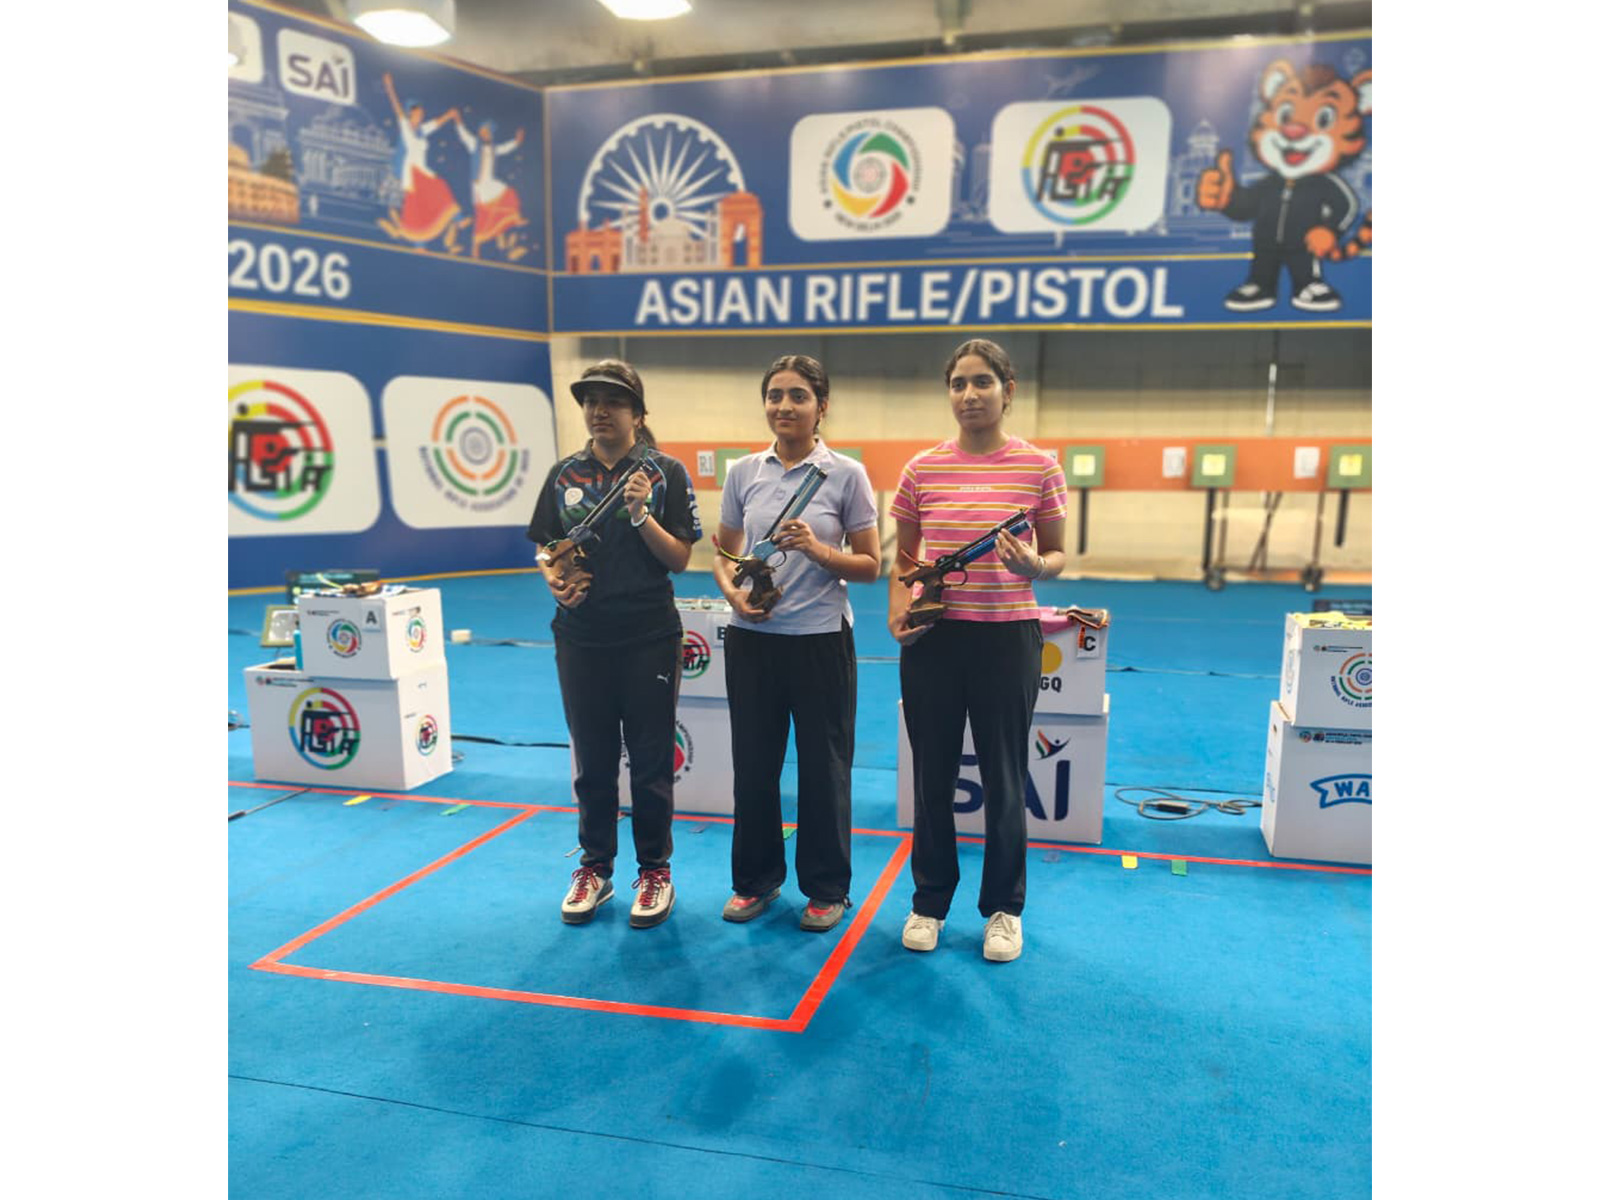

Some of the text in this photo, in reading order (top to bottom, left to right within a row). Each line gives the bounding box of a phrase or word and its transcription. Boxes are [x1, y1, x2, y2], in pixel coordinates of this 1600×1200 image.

[287, 54, 349, 98] SAI
[228, 239, 350, 299] 2026
[635, 267, 1184, 325] ASIAN RIFLE/PISTOL
[365, 610, 378, 625] A
[1083, 636, 1097, 651] C
[1333, 780, 1371, 797] WA
